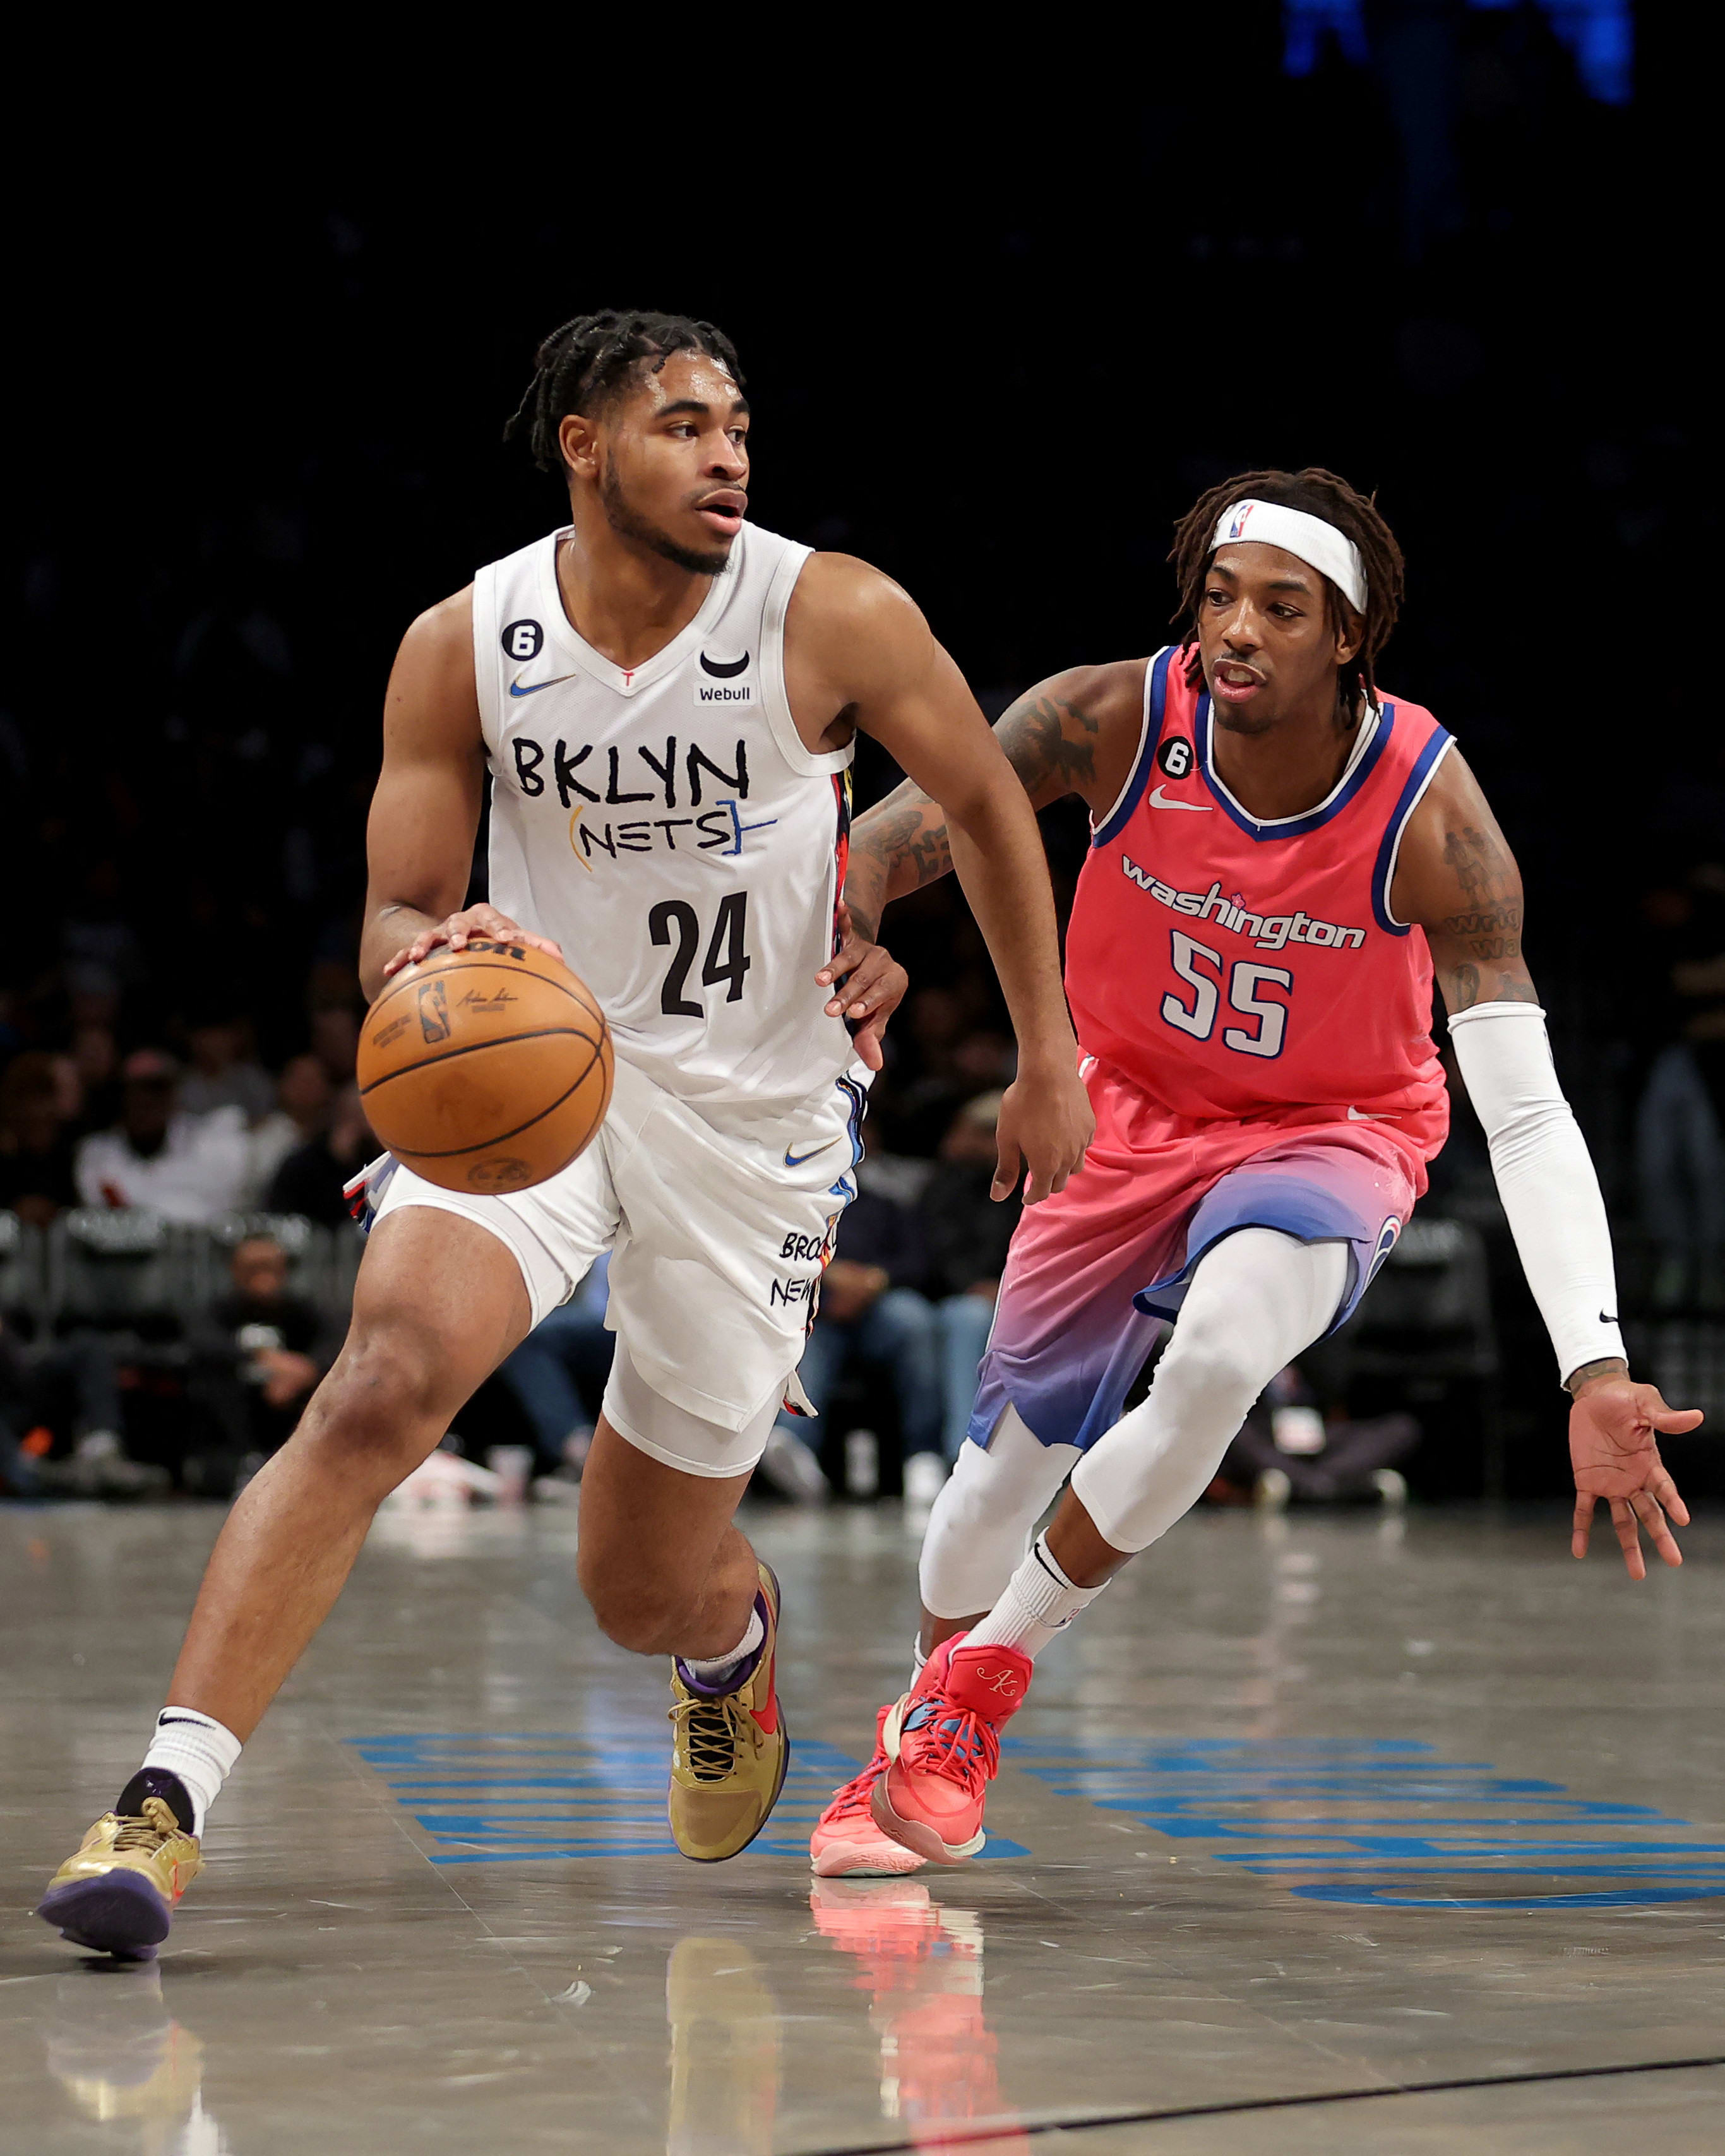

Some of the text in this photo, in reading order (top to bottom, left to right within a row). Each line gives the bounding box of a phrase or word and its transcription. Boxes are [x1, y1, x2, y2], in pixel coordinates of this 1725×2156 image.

[511, 623, 536, 656] 6
[700, 686, 750, 701] Webull
[512, 735, 750, 809] BKLYN
[1164, 741, 1190, 775] 6
[1121, 854, 1367, 950] washington
[648, 890, 751, 1018] 24
[1159, 929, 1294, 1060] 55
